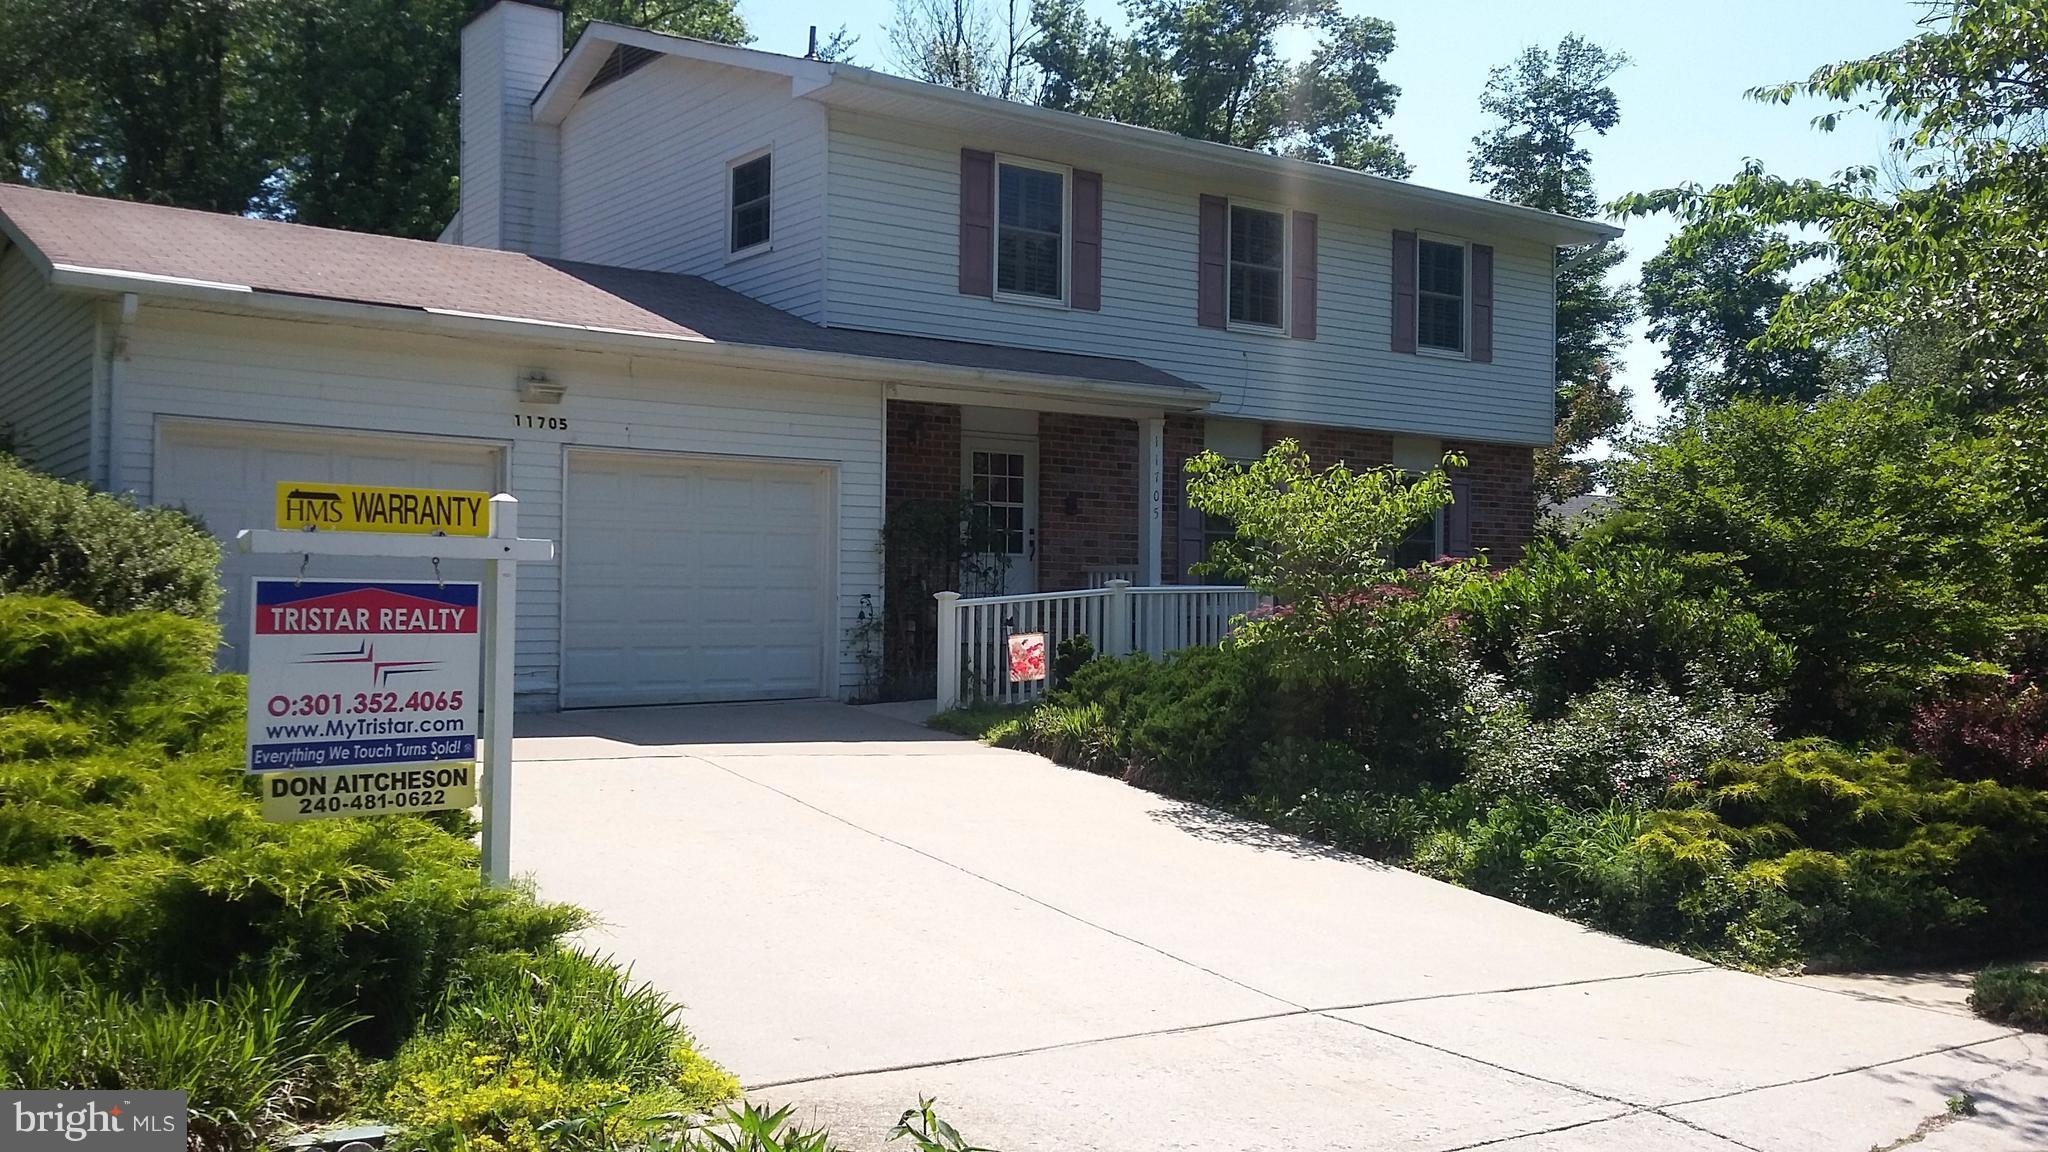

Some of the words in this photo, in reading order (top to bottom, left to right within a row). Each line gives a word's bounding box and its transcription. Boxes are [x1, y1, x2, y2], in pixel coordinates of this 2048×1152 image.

[514, 414, 568, 430] 11705
[286, 499, 343, 523] HMS
[352, 491, 482, 527] WARRANTY
[271, 608, 370, 632] TRISTAR
[379, 608, 466, 632] REALTY
[267, 691, 464, 717] O:301.352.4065
[266, 718, 464, 739] www.MyTristar.com
[254, 749, 325, 766] Everything
[329, 749, 350, 759] We
[353, 745, 393, 758] Touch
[396, 743, 427, 757] Turns
[430, 740, 461, 755] Sold!
[271, 776, 327, 798] DON
[333, 768, 468, 793] AITCHESON
[299, 789, 445, 814] 240-481-0622
